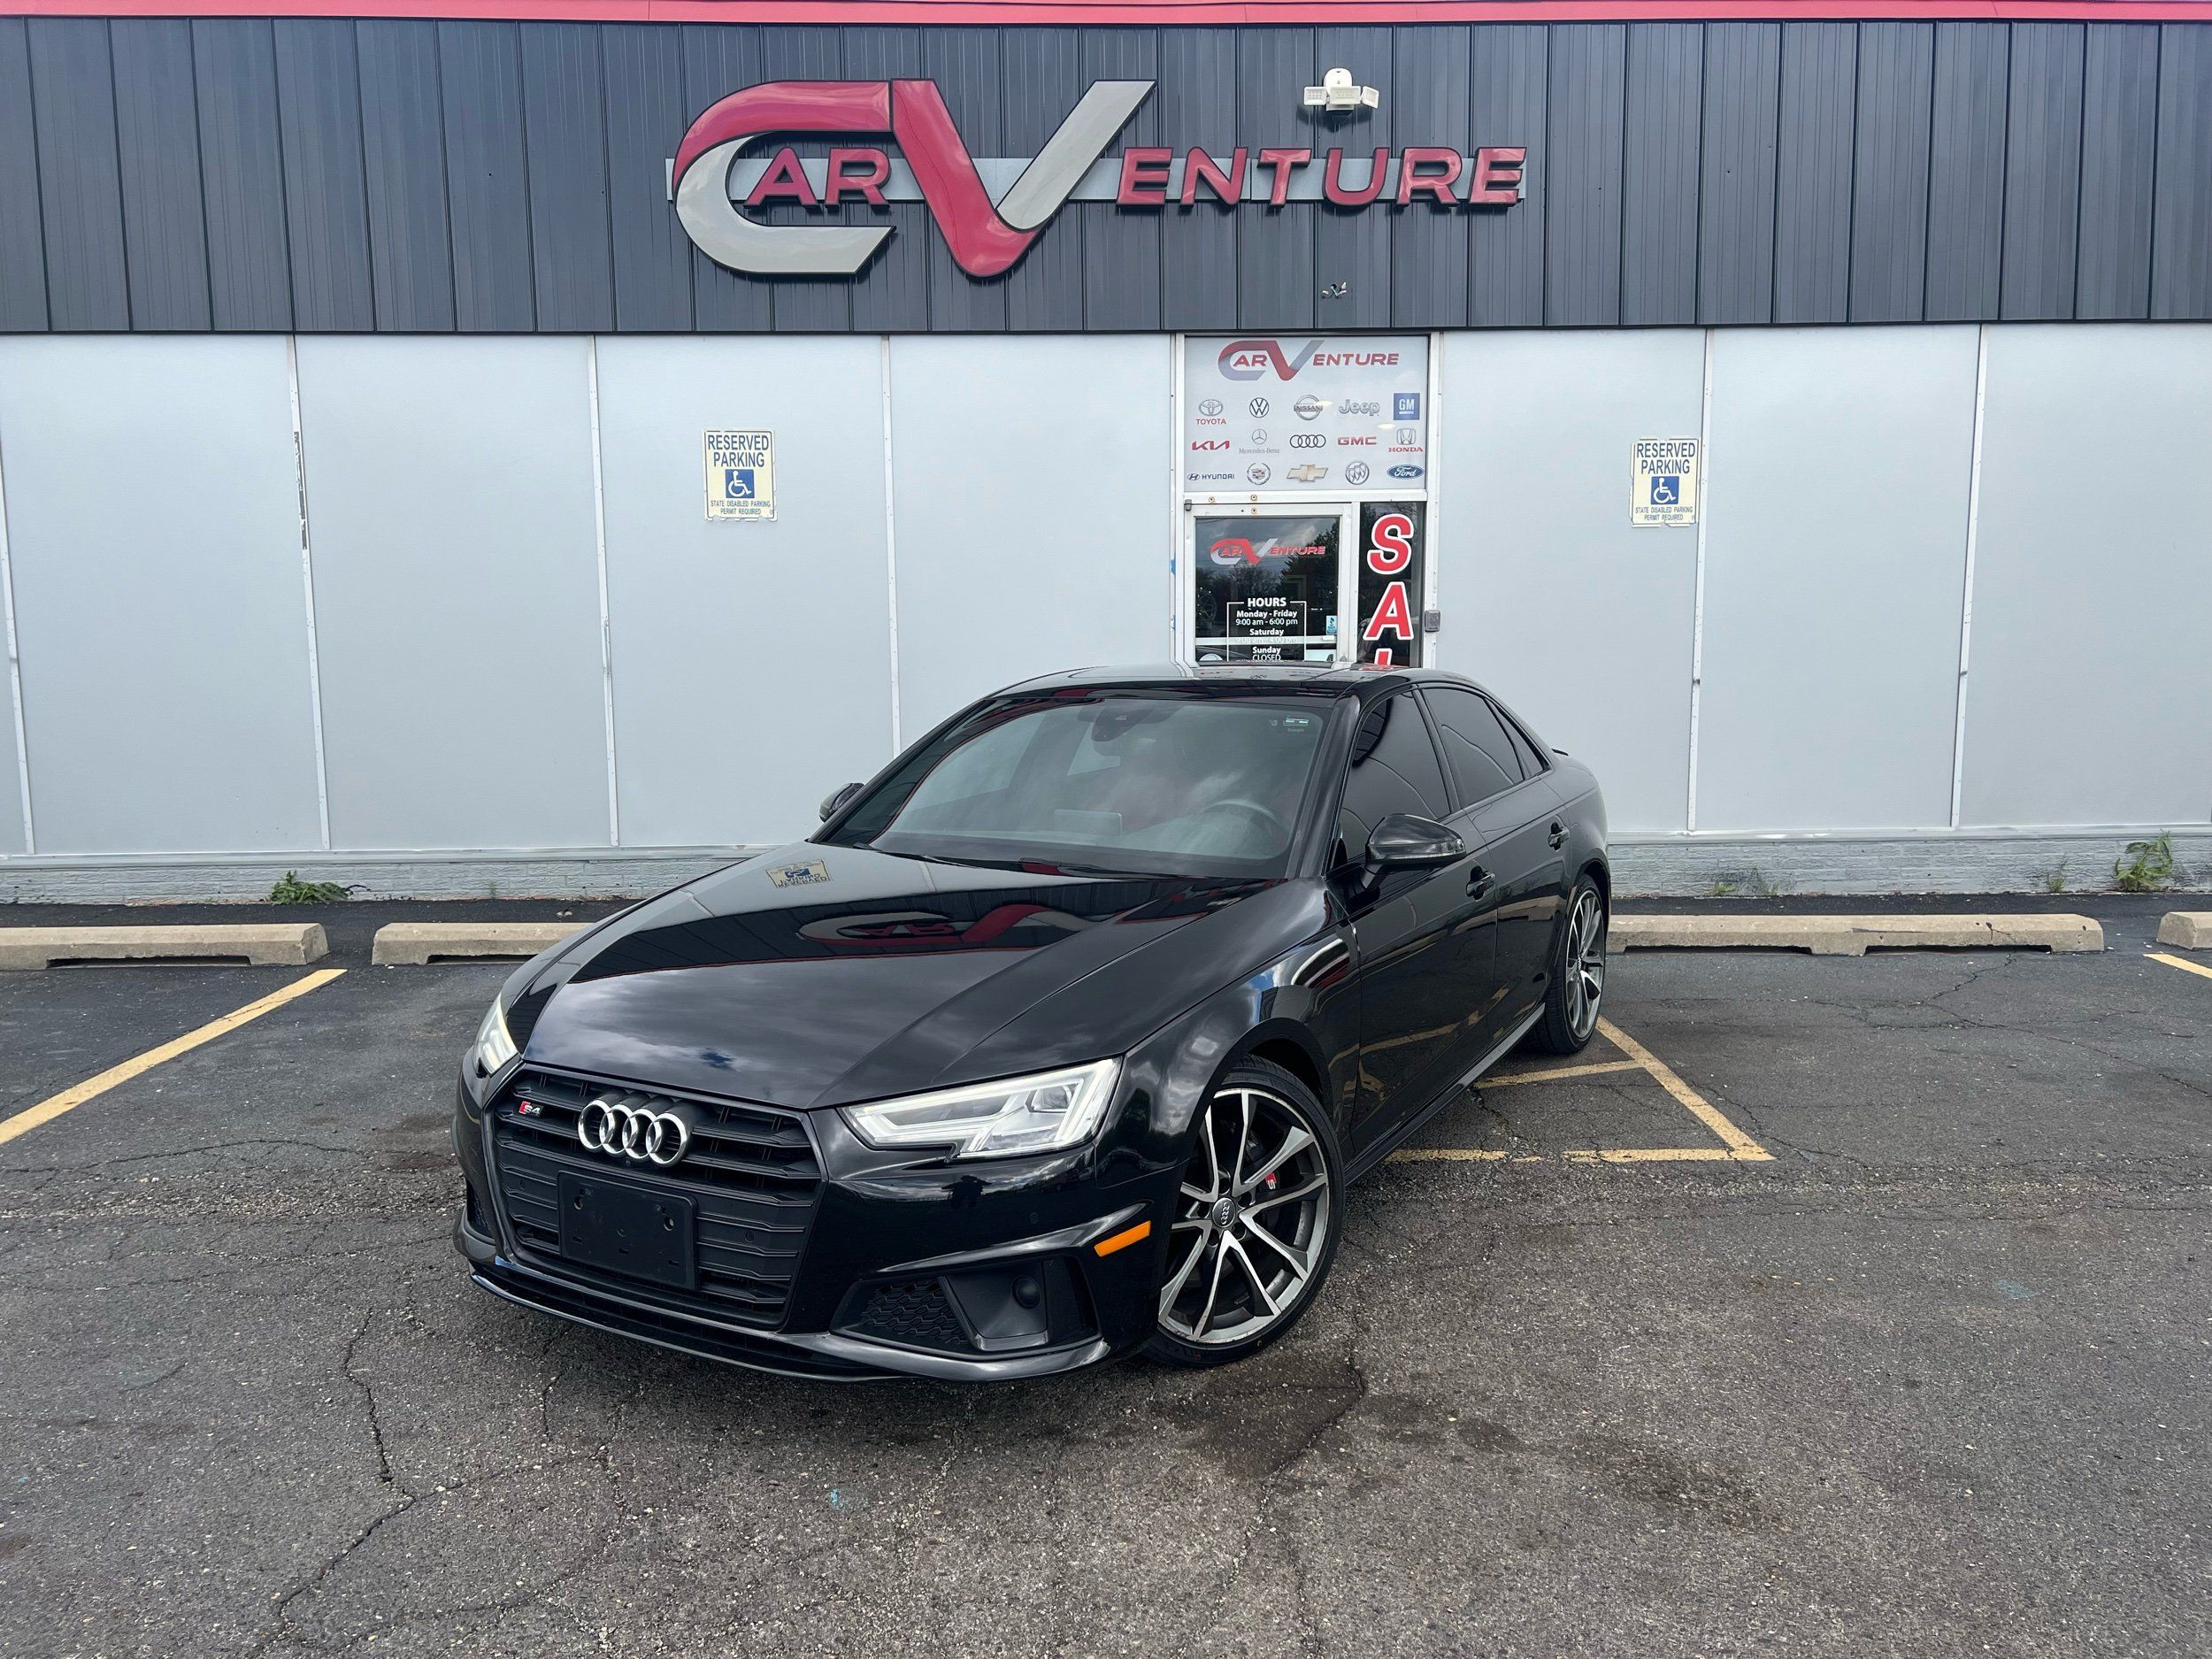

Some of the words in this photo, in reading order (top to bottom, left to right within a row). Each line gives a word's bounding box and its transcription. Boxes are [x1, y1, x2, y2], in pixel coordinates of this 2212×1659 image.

[1339, 399, 1380, 416] Jeep
[1399, 399, 1415, 411] GM
[708, 434, 769, 450] RESERVED
[1192, 441, 1230, 450] KIA
[1338, 436, 1377, 445] GMC
[1637, 442, 1696, 457] RESERVED
[713, 452, 764, 467] PARKING
[1394, 467, 1417, 477] Ford
[1641, 459, 1690, 474] PARKING
[1363, 513, 1414, 666] SA
[1247, 597, 1287, 608] HOURS
[1236, 610, 1268, 619] Monday
[1273, 609, 1298, 618] Friday
[1249, 628, 1285, 637] Saturday
[1252, 646, 1281, 655] Sunday
[523, 1104, 541, 1115] S4
